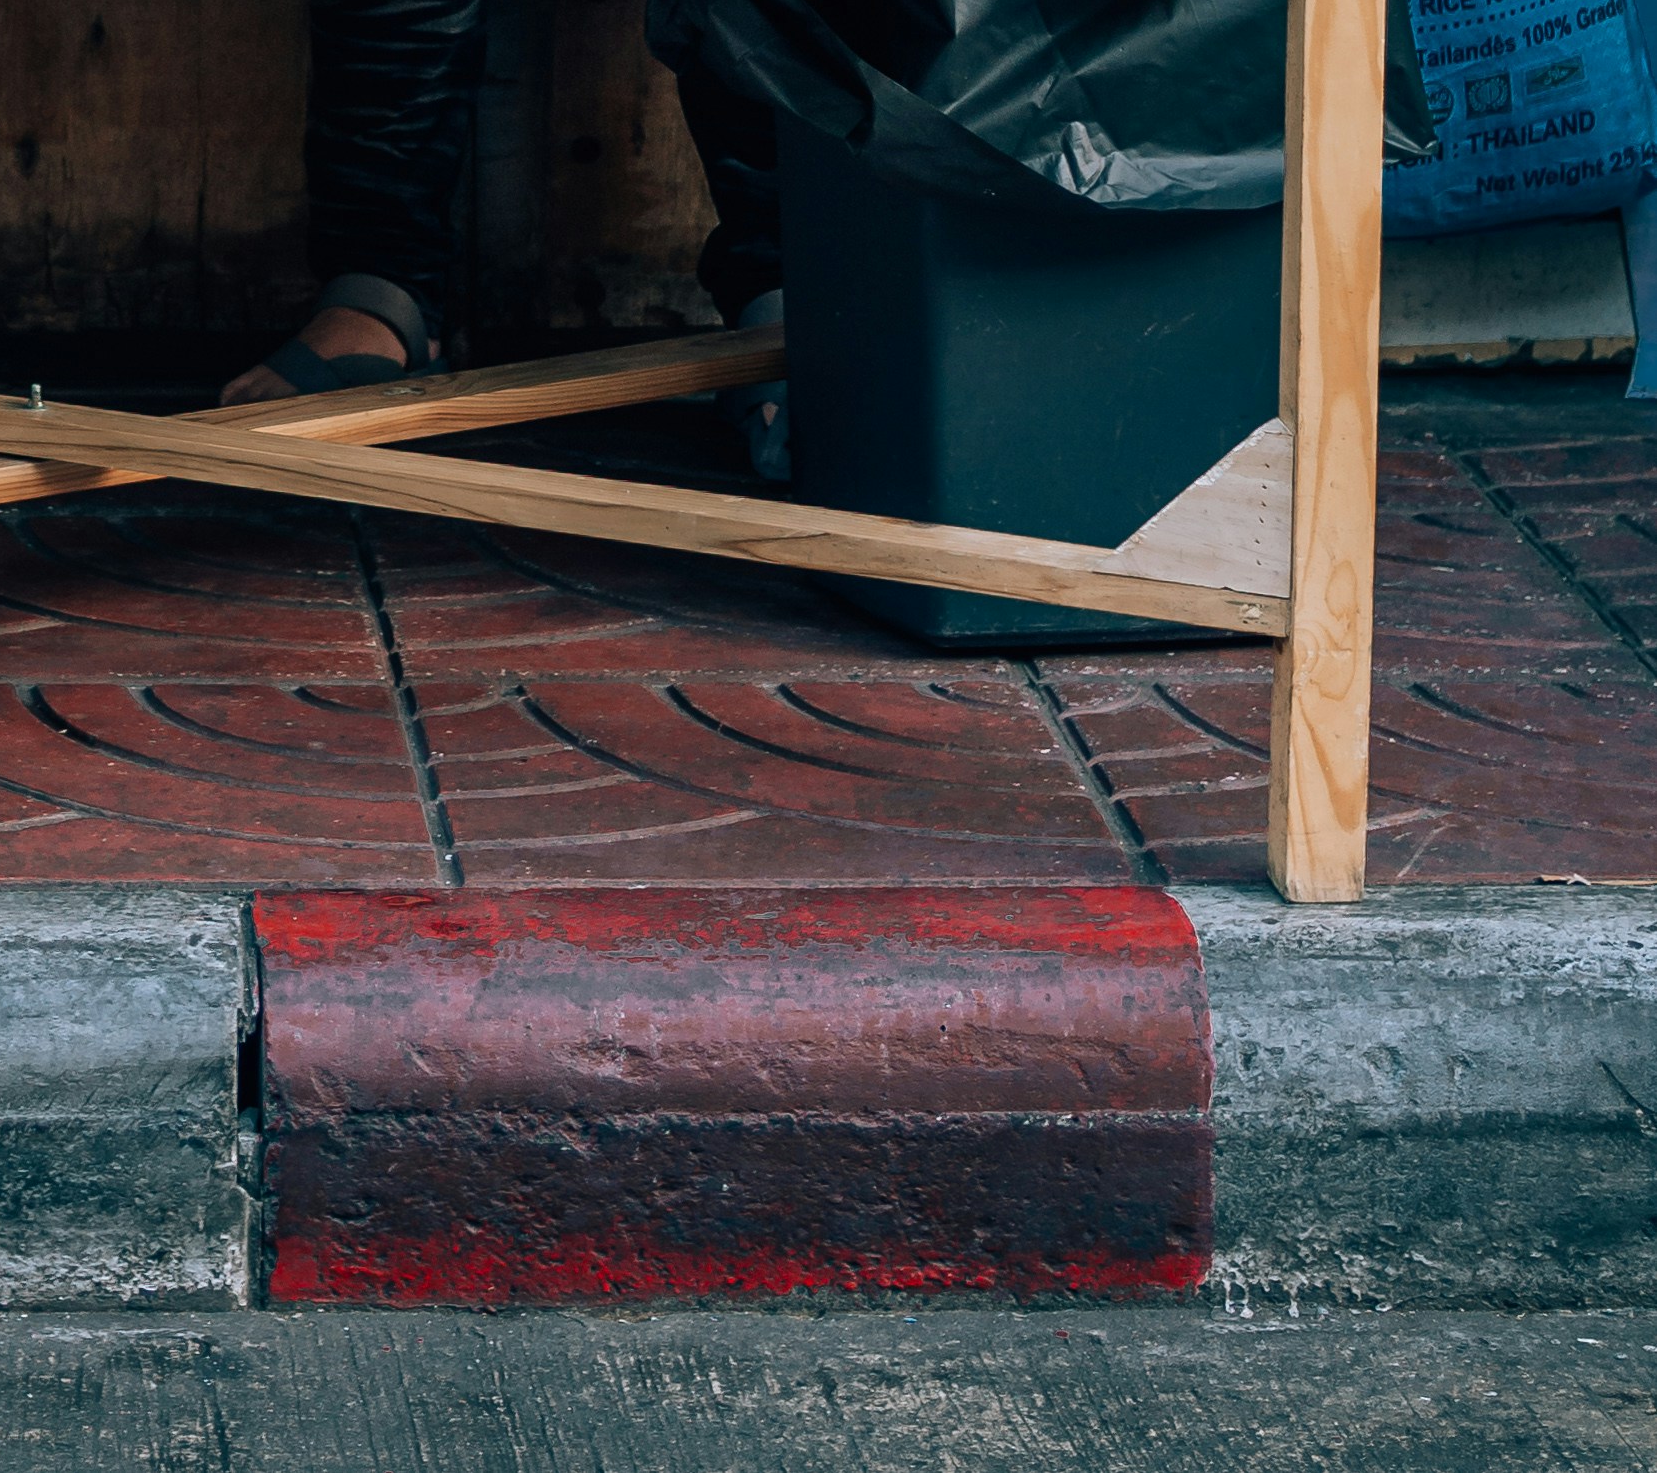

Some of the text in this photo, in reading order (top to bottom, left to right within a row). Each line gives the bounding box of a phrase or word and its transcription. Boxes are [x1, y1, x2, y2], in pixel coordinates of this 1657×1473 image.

[1522, 14, 1572, 49] 100%
[1467, 110, 1596, 155] THAILAND
[1476, 172, 1516, 194] Net
[1523, 161, 1605, 187] Weight
